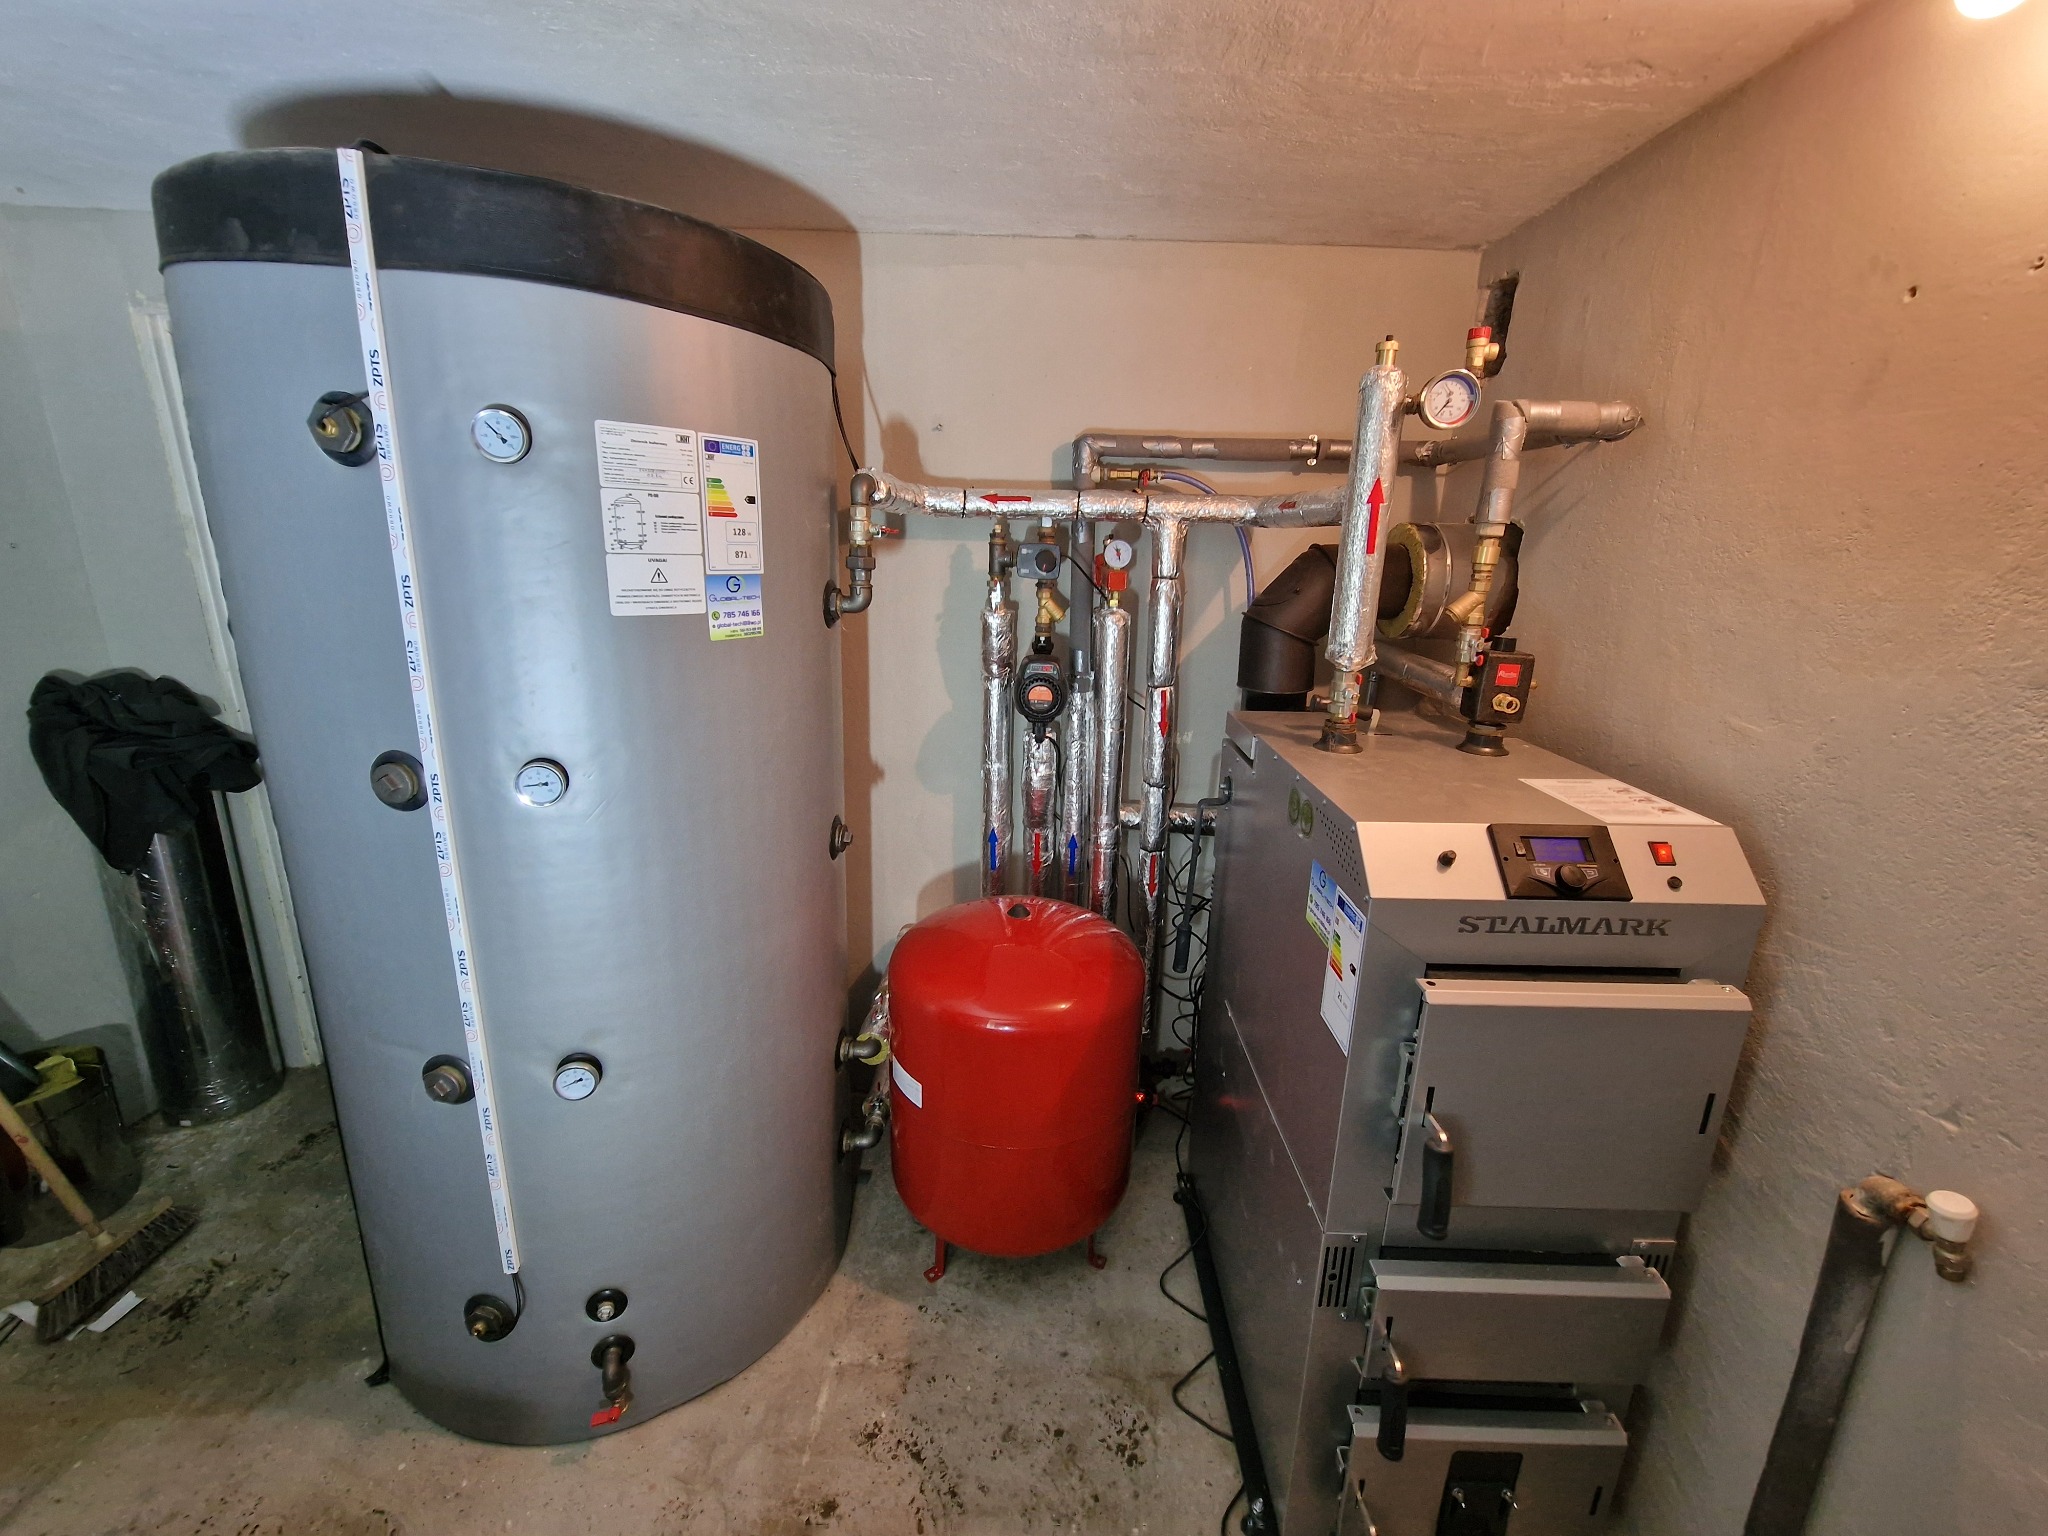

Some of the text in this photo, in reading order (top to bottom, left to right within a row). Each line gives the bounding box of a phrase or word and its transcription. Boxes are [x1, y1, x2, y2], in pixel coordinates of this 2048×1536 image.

[369, 349, 383, 387] ZPTS
[721, 442, 741, 453] ENERG
[733, 528, 746, 536] 128
[735, 551, 748, 559] 871
[401, 574, 414, 608] ZPTS
[726, 575, 741, 593] G
[723, 611, 736, 619] 785
[737, 610, 750, 618] 746
[430, 773, 442, 803] ZPTS
[1319, 870, 1327, 888] G
[1458, 916, 1672, 937] STALMARK
[457, 950, 468, 976] ZPTS
[482, 1107, 492, 1131] ZPTS
[505, 1249, 515, 1271] ZPTS
